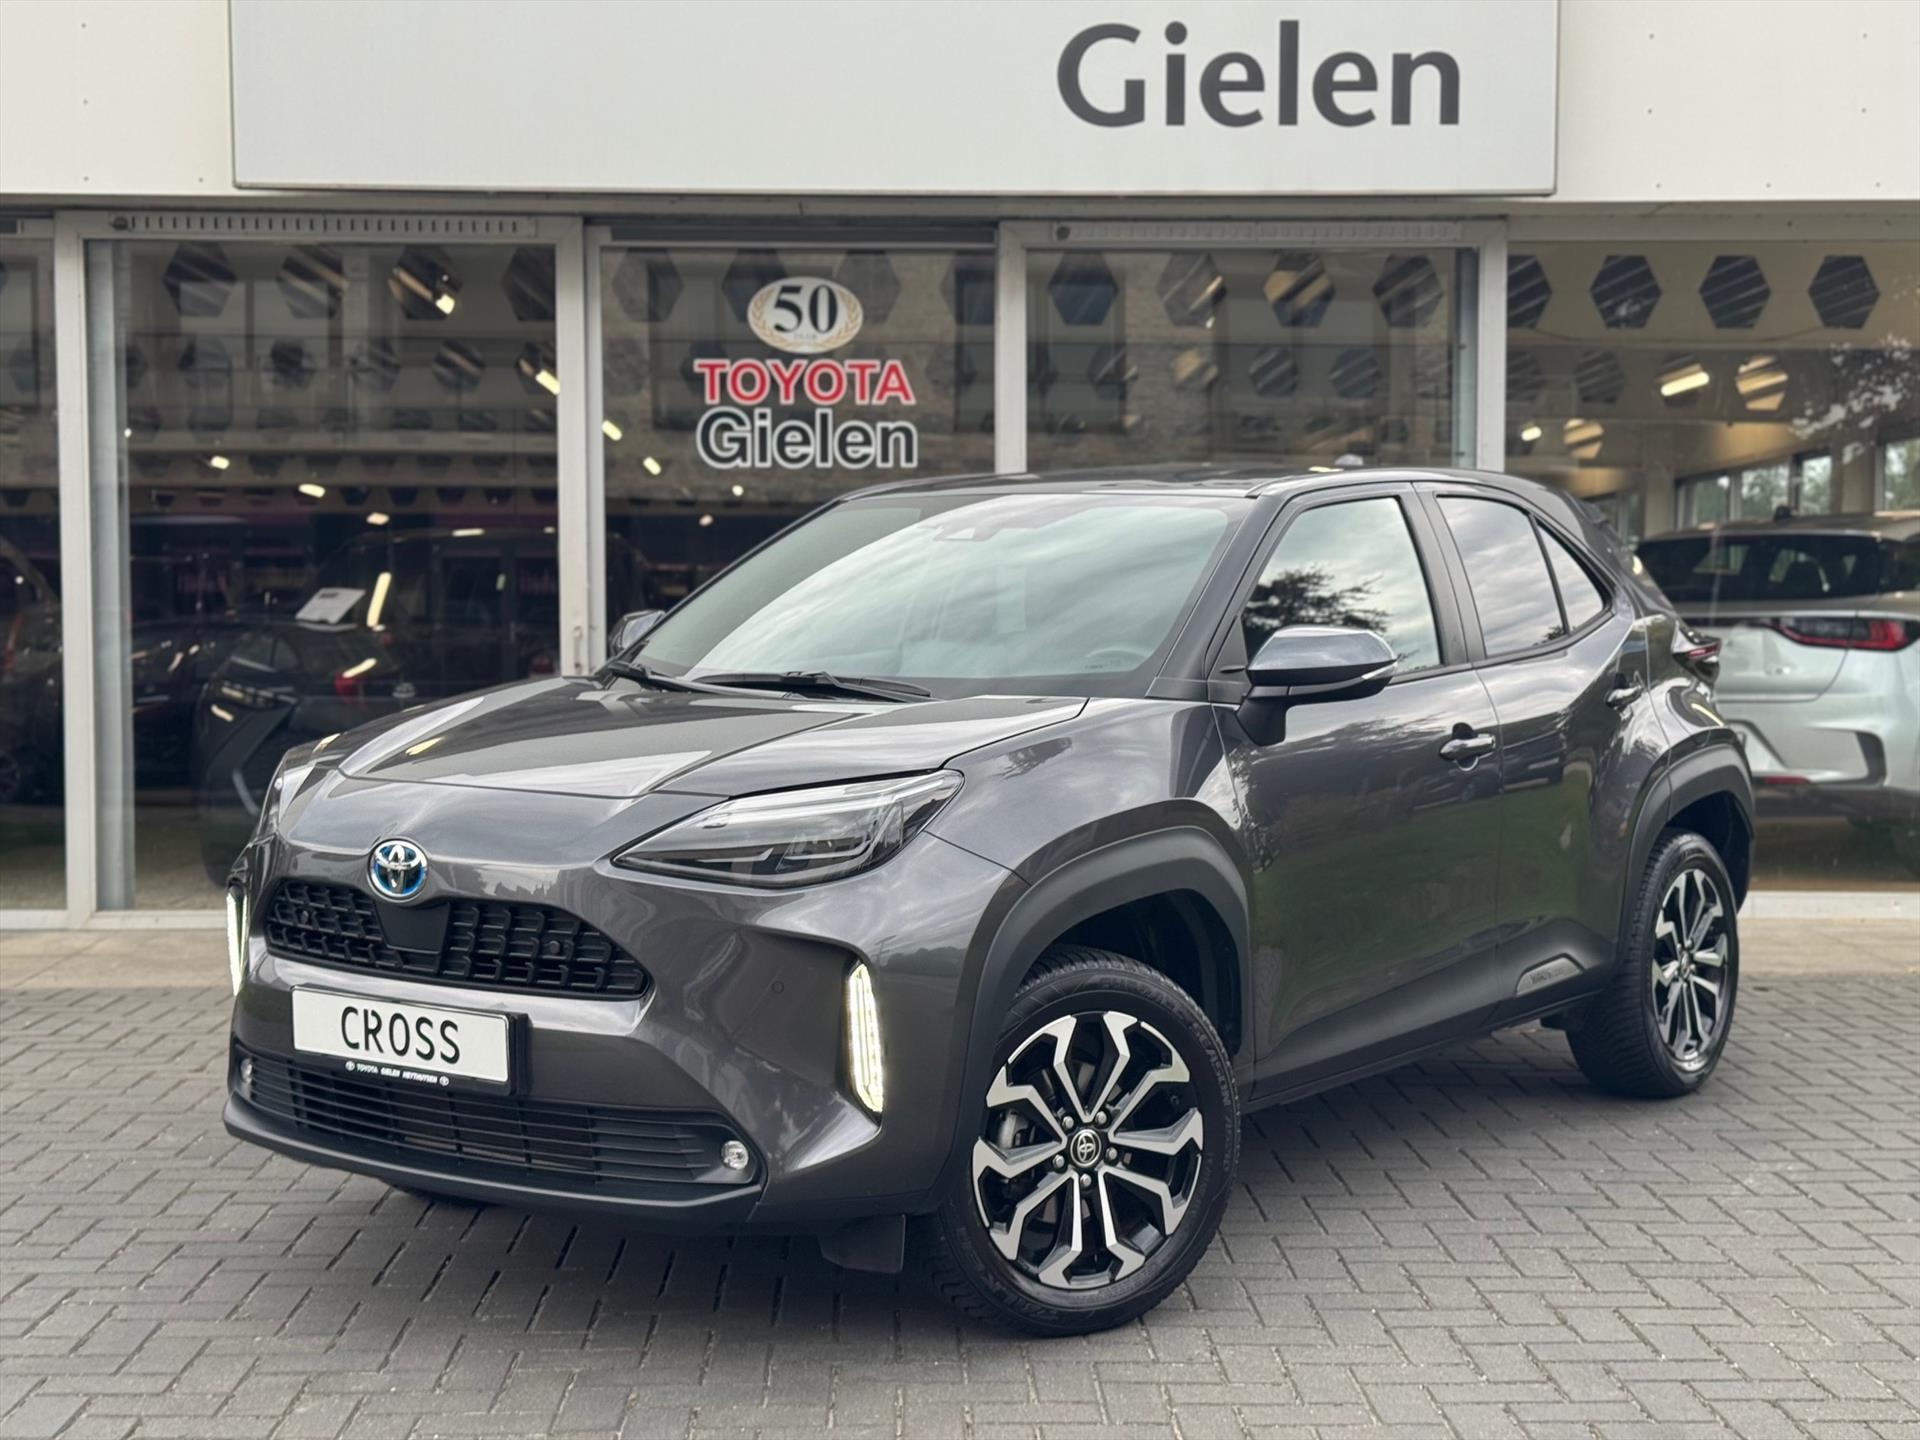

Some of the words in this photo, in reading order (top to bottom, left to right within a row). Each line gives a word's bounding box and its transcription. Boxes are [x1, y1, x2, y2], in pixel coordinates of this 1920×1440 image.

[1058, 20, 1460, 127] Gielen
[774, 285, 838, 333] 50
[696, 360, 914, 404] TOYOTA
[697, 409, 917, 468] Gielen
[341, 1006, 460, 1065] CROSS
[357, 1063, 379, 1074] TOYOTA
